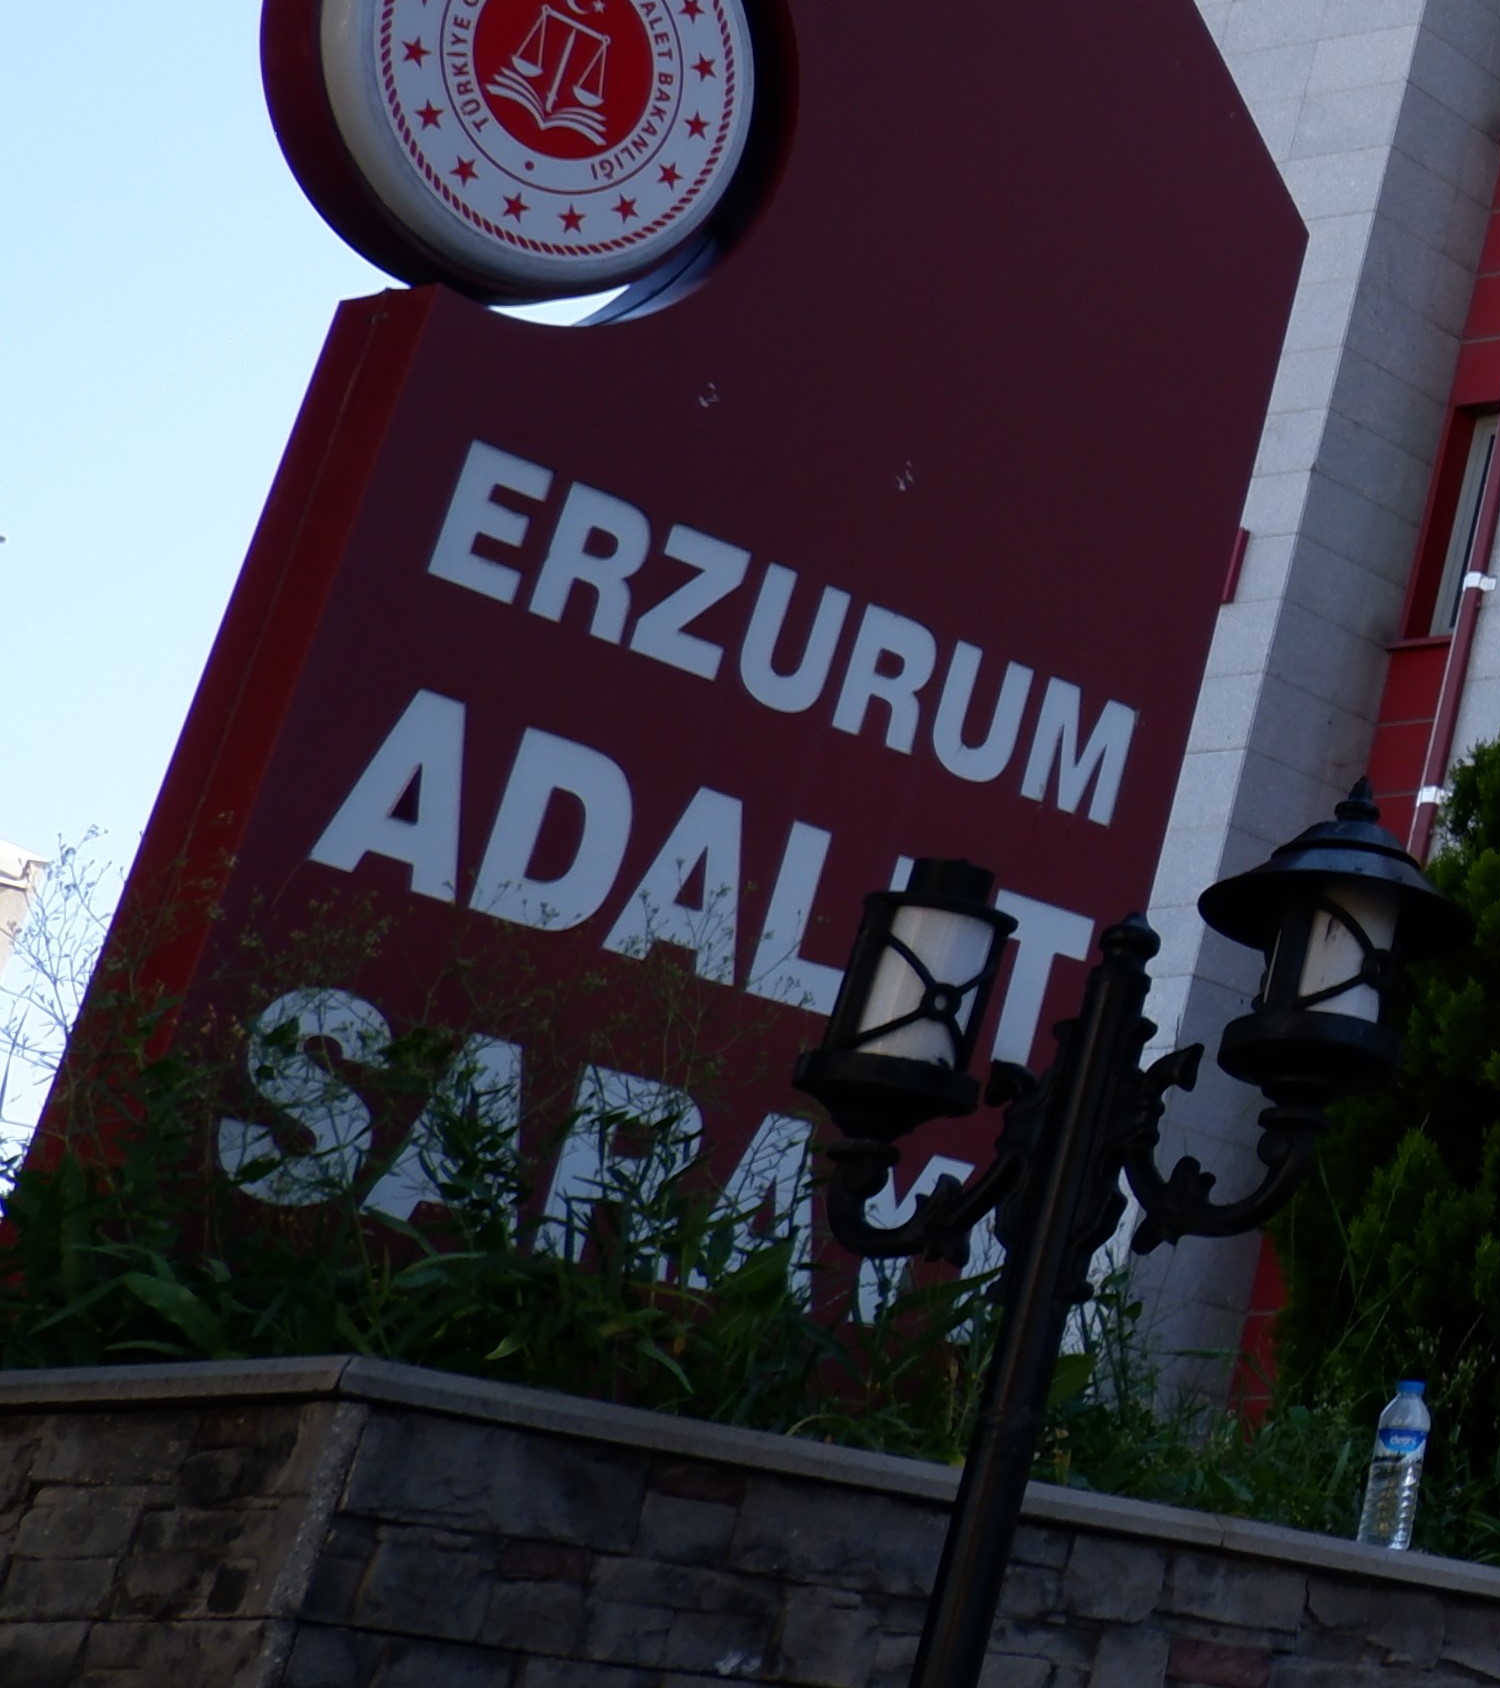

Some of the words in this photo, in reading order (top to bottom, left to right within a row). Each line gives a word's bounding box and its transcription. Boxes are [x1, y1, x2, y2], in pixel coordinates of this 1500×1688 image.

[446, 15, 489, 133] TÜRKİYE
[590, 71, 674, 181] BAKANLIĞI
[426, 439, 1141, 827] ERZURUM
[309, 688, 1095, 1066] ADALT
